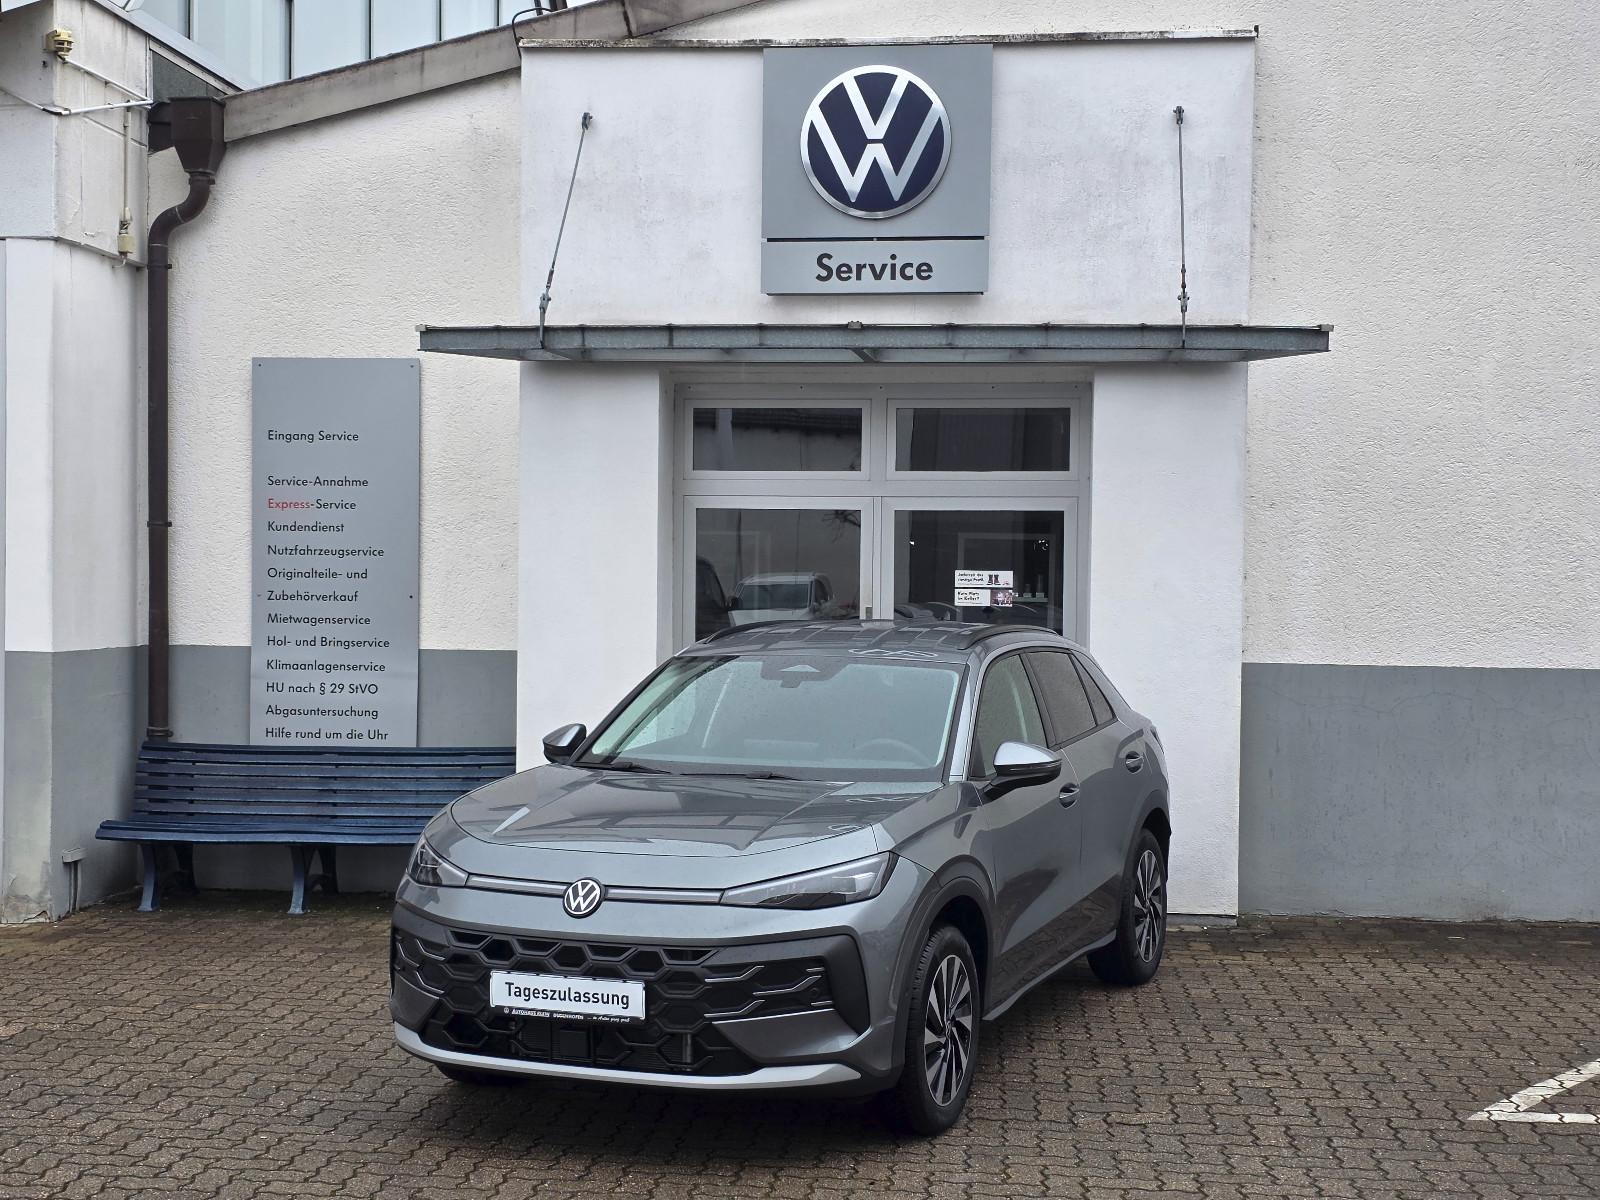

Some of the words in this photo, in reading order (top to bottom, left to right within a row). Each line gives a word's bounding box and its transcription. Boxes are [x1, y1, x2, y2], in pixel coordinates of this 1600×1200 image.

[803, 67, 949, 212] VW
[816, 253, 933, 281] Service
[268, 430, 314, 443] Eingang
[318, 430, 358, 441] Service
[268, 476, 368, 486] Service-Annahme
[267, 498, 357, 512] Express-Service
[268, 521, 344, 533] Kundendienst
[268, 545, 384, 558] Nutzfahrzeugservice
[267, 568, 343, 580] Originalteile-
[347, 569, 367, 579] und
[267, 589, 358, 602] Zubehörverkauf
[268, 613, 370, 626] Mietwagenservice
[267, 635, 292, 646] Hol-
[296, 636, 316, 646] und
[321, 637, 390, 649] Bringservice
[267, 659, 385, 673] Klimaanlagenservice
[267, 682, 284, 692] HU
[289, 682, 315, 693] nach
[330, 683, 344, 693] 29
[348, 684, 378, 694] StVO
[266, 704, 378, 719] Abgasuntersuchung
[266, 727, 291, 738] Hilfe
[296, 728, 321, 738] rund
[326, 731, 342, 739] um
[346, 729, 363, 739] die
[368, 729, 388, 740] Uhr
[565, 880, 600, 914] VW
[505, 981, 630, 1010] Tageszulassung
